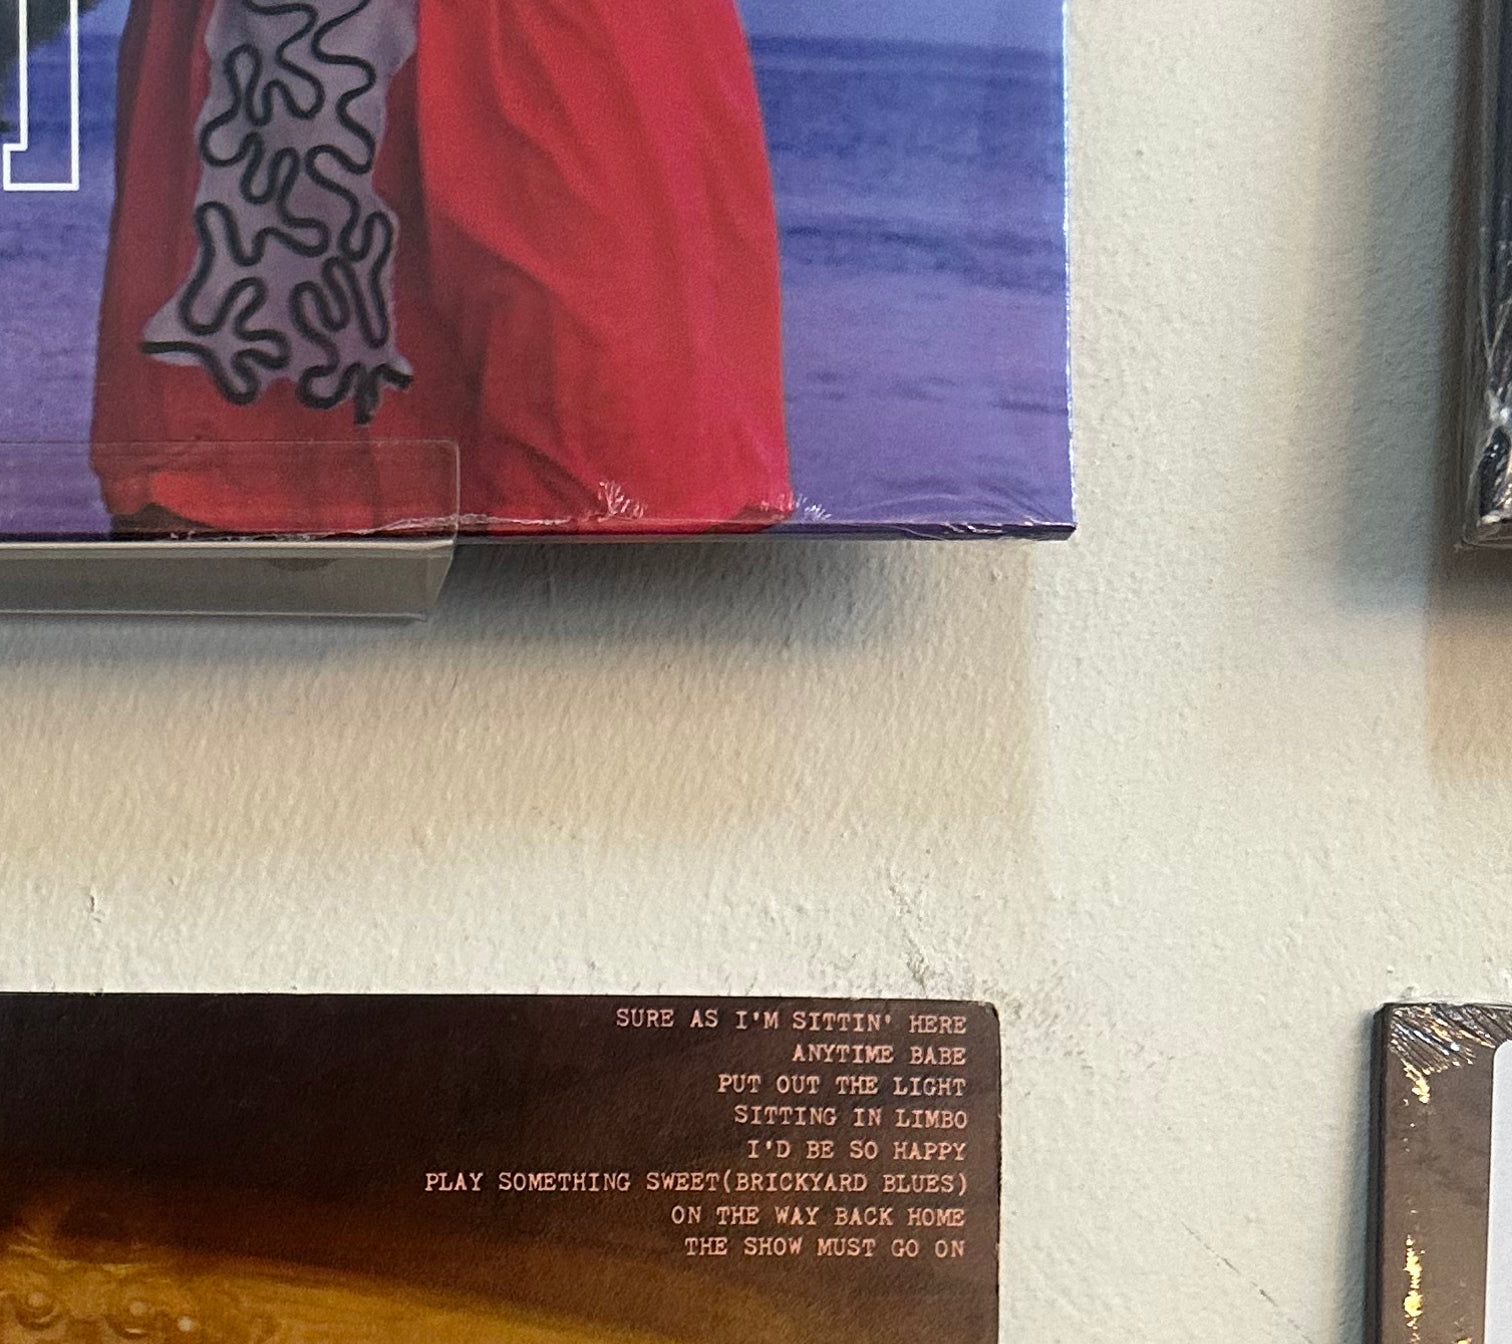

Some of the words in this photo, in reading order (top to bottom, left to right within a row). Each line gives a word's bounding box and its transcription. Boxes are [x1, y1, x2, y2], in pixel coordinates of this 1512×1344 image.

[616, 1008, 674, 1028] SURE
[690, 1009, 718, 1029] AS
[736, 1011, 779, 1030] I'M
[792, 1011, 892, 1032] SITTIN'
[909, 1016, 967, 1034] HERE
[792, 1044, 894, 1064] ANYTIME
[909, 1046, 967, 1066] BABE
[717, 1074, 761, 1093] PUT
[776, 1075, 820, 1094] OUT
[836, 1076, 878, 1095] THE
[892, 1077, 967, 1097] LIGHT
[734, 1105, 837, 1126] SITTING
[853, 1108, 881, 1127] IN
[895, 1109, 967, 1129] LIMBO
[747, 1140, 791, 1158] I'D
[806, 1141, 834, 1159] BE
[849, 1140, 878, 1159] SO
[893, 1141, 967, 1161] HAPPY
[425, 1172, 484, 1191] PLAY
[498, 1172, 631, 1192] SOMETHING
[646, 1170, 868, 1194] SWEET(BRICKYARD
[882, 1173, 967, 1197] BLUES)
[671, 1206, 700, 1225] ON
[716, 1206, 759, 1225] THE
[775, 1206, 819, 1225] WAY
[834, 1207, 894, 1226] BACK
[907, 1208, 966, 1227] HOME
[685, 1237, 728, 1256] THE
[743, 1237, 803, 1256] SHOW
[817, 1237, 877, 1257] MUST
[891, 1238, 920, 1257] GO
[935, 1239, 966, 1258] ON
